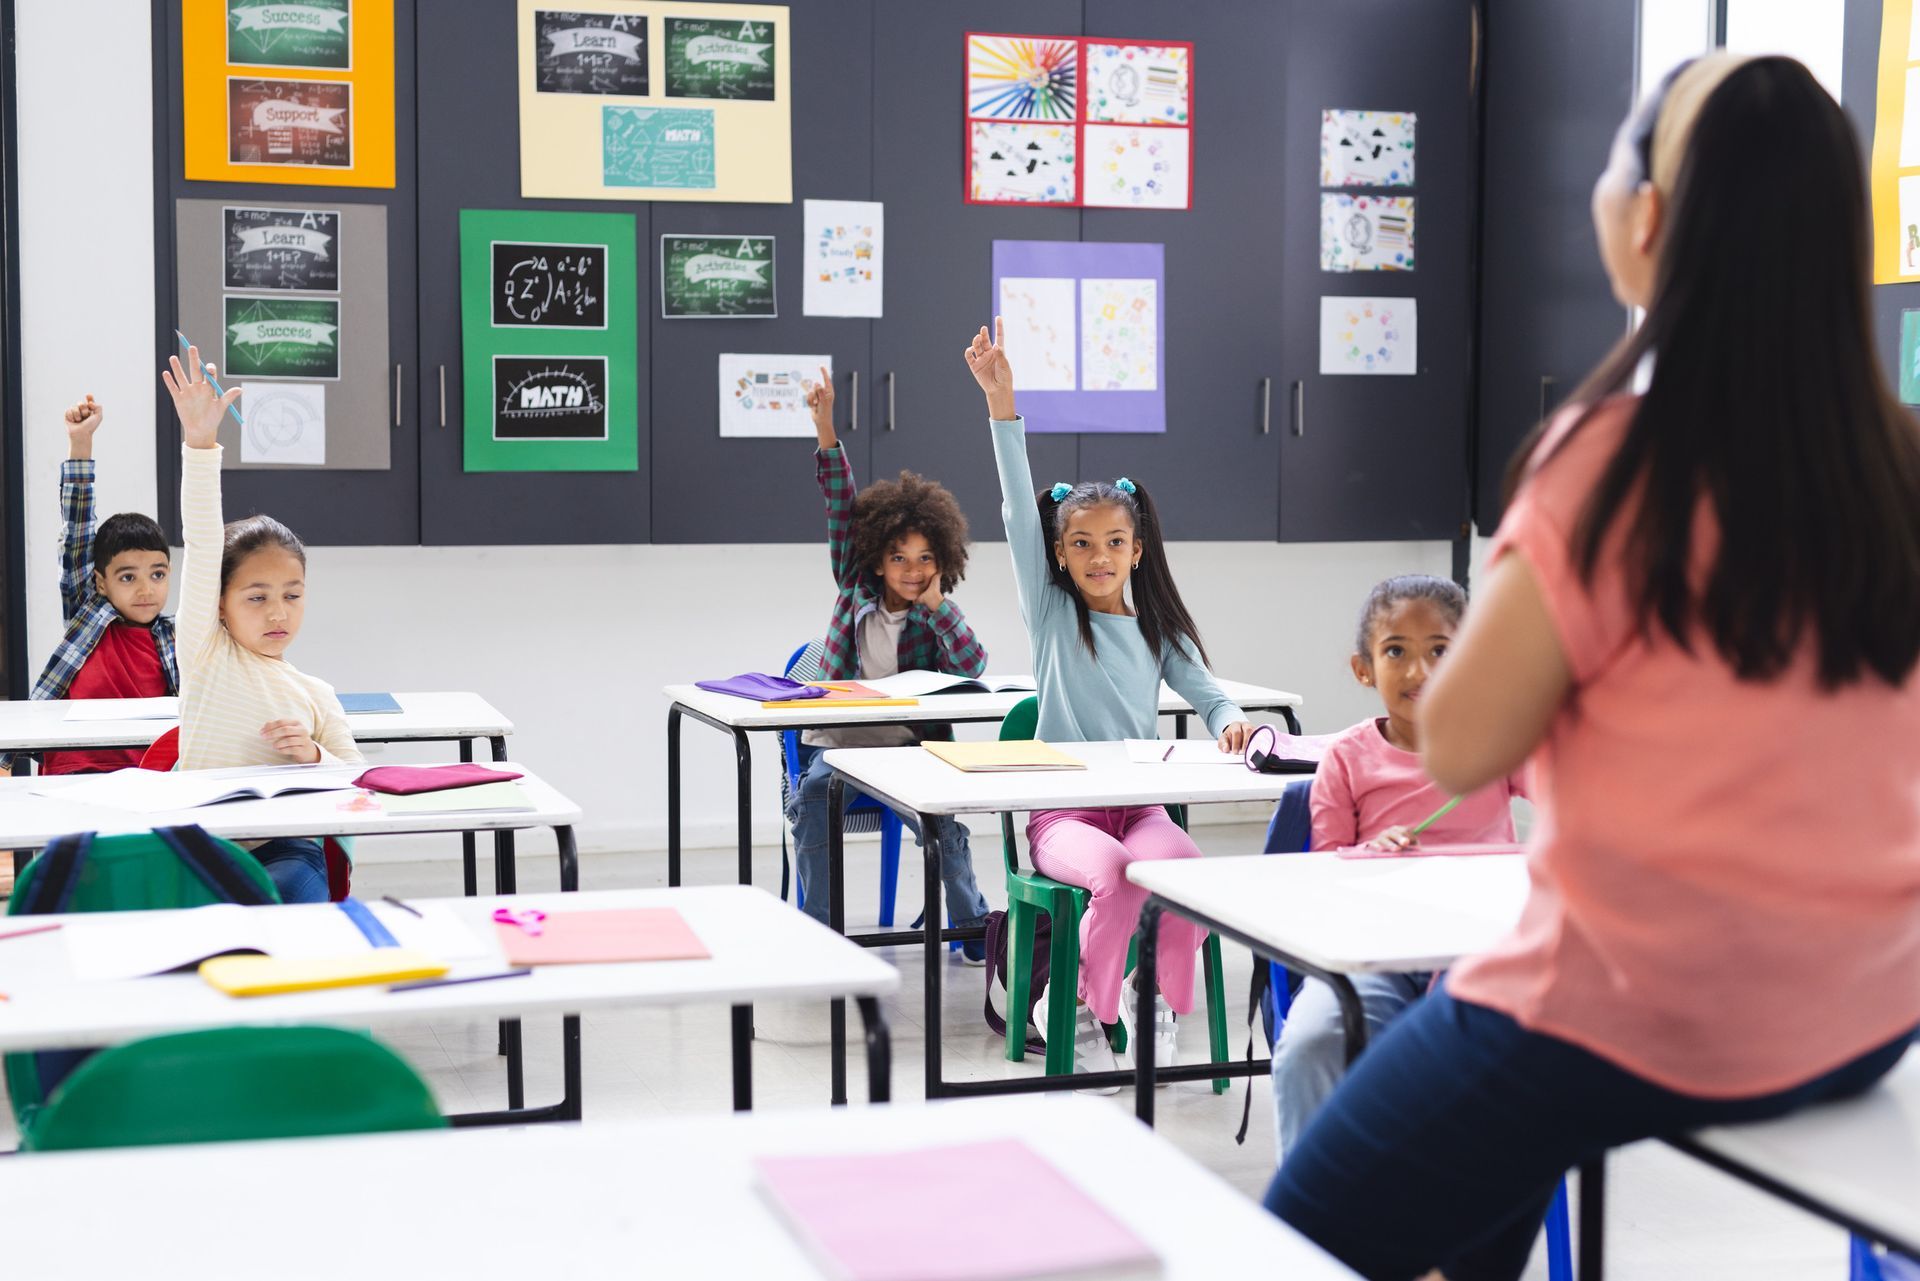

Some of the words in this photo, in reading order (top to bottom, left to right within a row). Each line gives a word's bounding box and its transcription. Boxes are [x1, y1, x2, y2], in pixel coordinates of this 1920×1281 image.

[262, 9, 321, 25] Success
[610, 15, 641, 32] A+
[737, 20, 769, 41] A+
[572, 32, 617, 48] Learn
[266, 107, 319, 123] Support
[300, 211, 331, 230] A+
[262, 231, 305, 246] Learn
[736, 238, 767, 259] A+
[257, 324, 312, 339] Success
[520, 385, 584, 409] MATH
